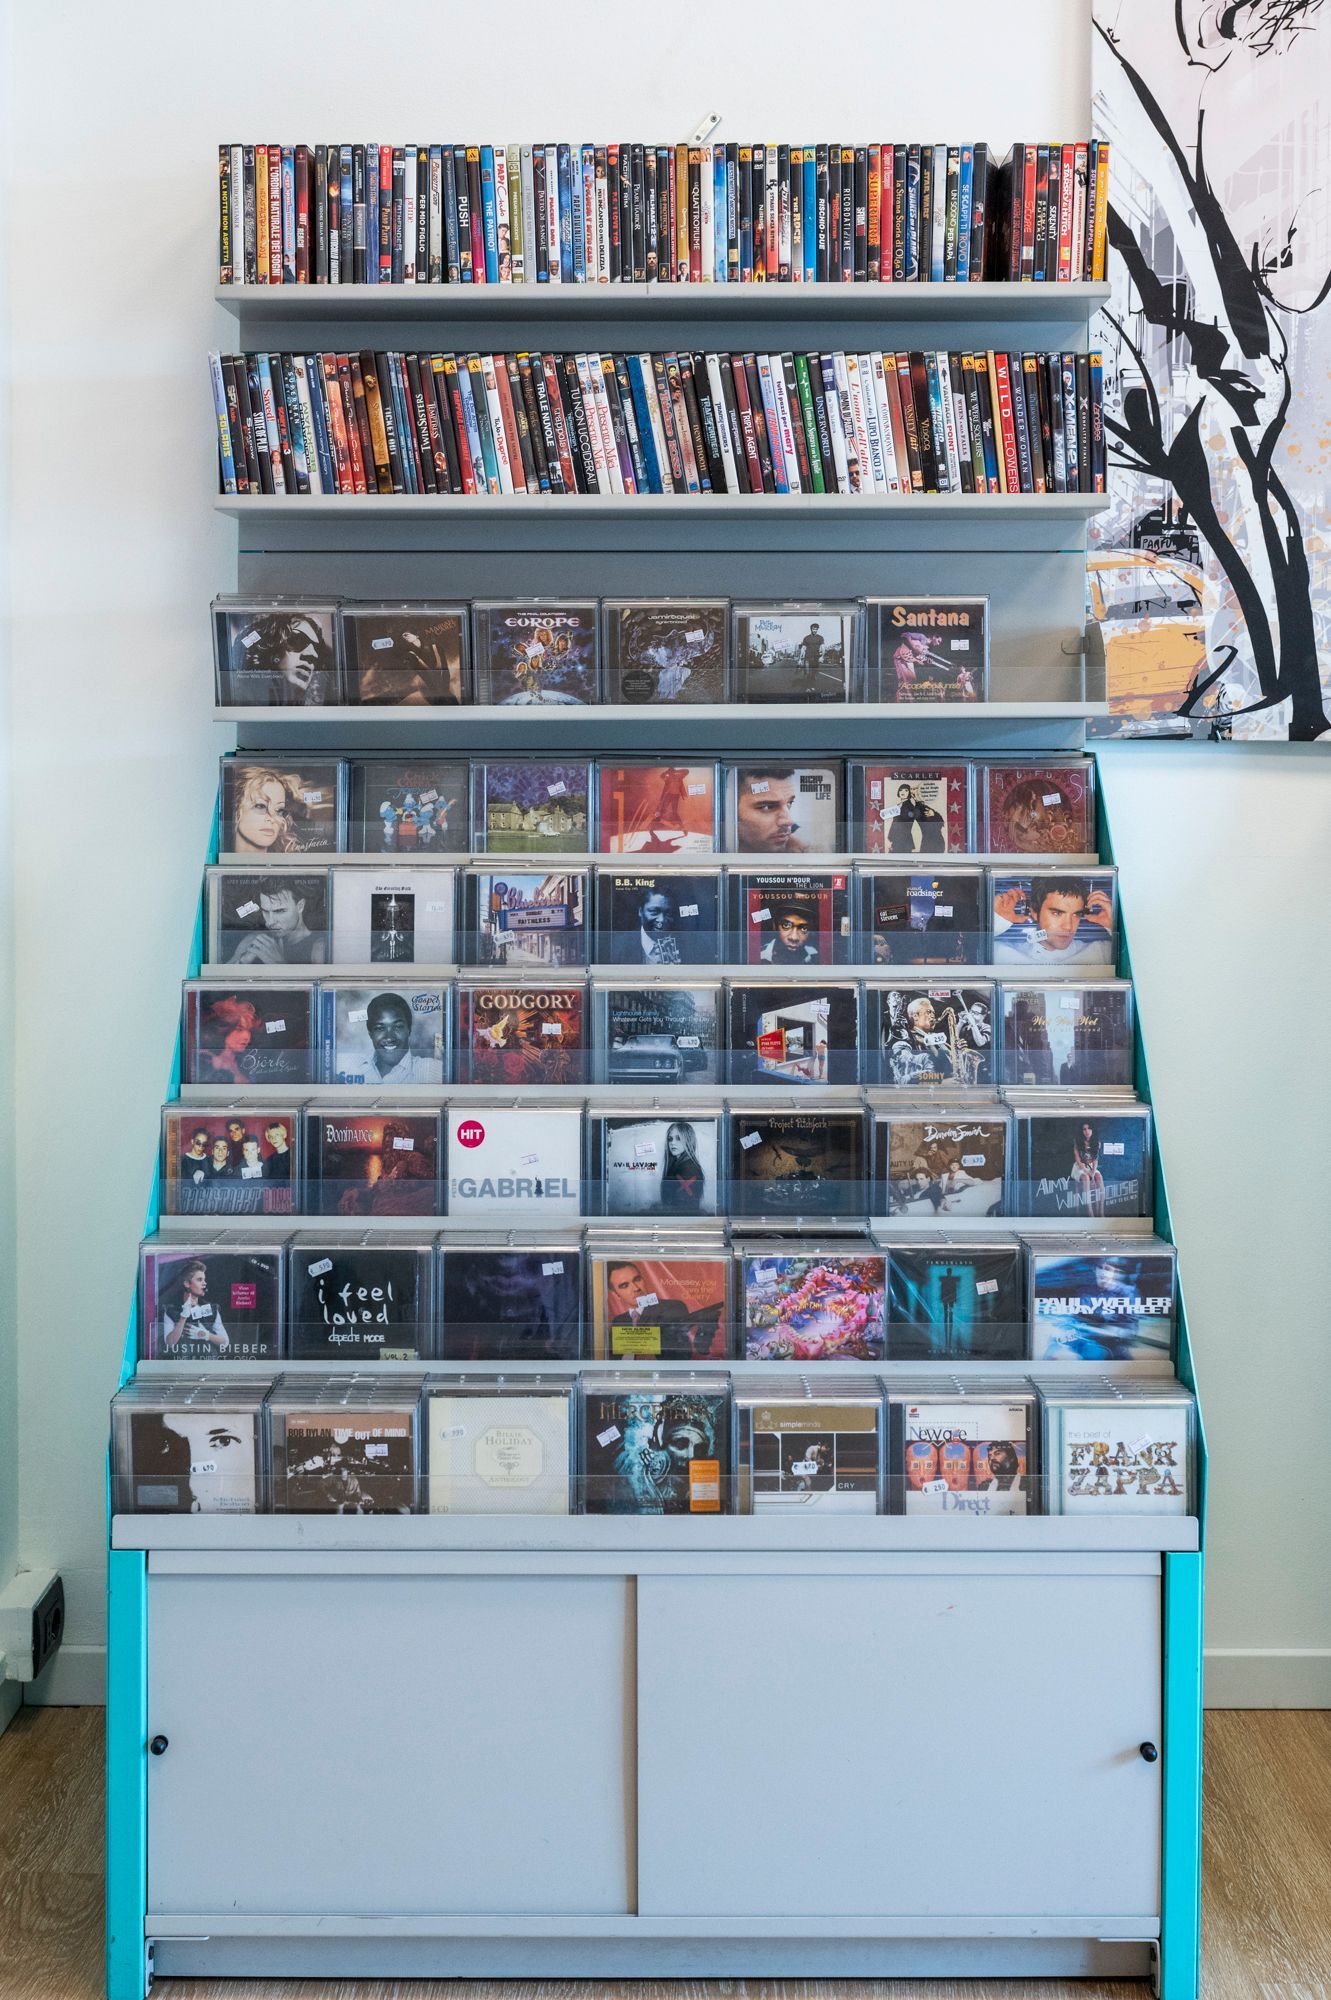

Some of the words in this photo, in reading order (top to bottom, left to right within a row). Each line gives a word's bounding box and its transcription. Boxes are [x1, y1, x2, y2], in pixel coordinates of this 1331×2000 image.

[222, 180, 228, 189] LA
[270, 167, 279, 199] L'ORDINE
[962, 184, 969, 192] SE
[895, 189, 903, 213] Strana
[951, 189, 957, 200] UN
[458, 196, 468, 227] PUSH
[485, 200, 493, 216] THE
[843, 189, 851, 230] RICORDATI
[271, 201, 280, 238] NATURALE
[895, 215, 903, 238] Storia
[1047, 205, 1057, 240] SERENITY
[272, 240, 280, 252] DEI
[487, 219, 495, 252] PATRIOT
[844, 240, 851, 251] ME
[272, 254, 280, 276] SOGNI
[895, 270, 904, 278] O
[227, 385, 237, 408] SPY
[288, 372, 299, 424] SUPERMAN
[537, 382, 546, 400] TRA
[570, 388, 579, 399] TU
[970, 391, 977, 402] WE
[263, 389, 275, 422] Saved!
[540, 401, 547, 411] LE
[573, 402, 584, 426] NON
[943, 385, 952, 424] VANTAGE
[971, 404, 979, 423] WERE
[1015, 387, 1027, 431] WONDER
[385, 407, 395, 436] TICKET
[741, 408, 753, 434] TRIPLE
[780, 416, 788, 428] per
[815, 396, 831, 457] UNDERWORLD
[867, 416, 876, 438] LUPO
[906, 403, 915, 432] VANITY
[1065, 393, 1076, 449] X-MEN
[219, 415, 231, 457] SOLARIS
[246, 417, 255, 459] SHADOW
[542, 412, 554, 447] NUVOLE
[998, 367, 1010, 418] WILD
[1005, 433, 1018, 492] FLOWERS
[497, 437, 508, 465] Dupree
[693, 424, 701, 443] new
[697, 445, 708, 471] moon
[746, 436, 757, 459] AGENT
[783, 429, 793, 455] mary
[857, 427, 869, 477] dell'altra
[907, 432, 919, 452] fair
[870, 439, 880, 467] BIANCO
[1019, 435, 1028, 473] WOMAN
[1054, 433, 1064, 480] X-MEN
[505, 617, 580, 629] EUROPE
[891, 606, 969, 627] Santana
[800, 776, 824, 784] RICKY
[800, 784, 831, 792] MARTIN
[815, 792, 831, 800] LIFE
[635, 879, 655, 888] King
[906, 888, 944, 898] roadsinger
[517, 917, 551, 925] FAITHLESS
[411, 996, 440, 1006] Gospel
[479, 994, 576, 1009] GODGORY
[917, 1072, 945, 1080] SONNY
[461, 1129, 482, 1139] HIT
[769, 1118, 794, 1133] Project
[1036, 1176, 1072, 1197] AMY
[1056, 1179, 1139, 1211] WINEHOUSE
[338, 1282, 393, 1307] feel
[1035, 1297, 1086, 1307] PAUL
[1089, 1297, 1171, 1307] WELLER
[323, 1304, 389, 1325] loved
[1101, 1305, 1169, 1315] STREET
[163, 1343, 211, 1354] JUSTIN
[219, 1343, 268, 1353] BIEBER
[363, 1334, 386, 1343] MODE
[288, 1428, 304, 1437] BOB
[305, 1428, 331, 1437] DYLAN
[333, 1428, 353, 1437] TIME
[355, 1431, 371, 1441] OUT
[372, 1428, 383, 1437] OF
[384, 1428, 407, 1437] MIND
[484, 1437, 534, 1446] HOLIDAY
[1066, 1441, 1178, 1467] FRANK
[838, 1482, 855, 1490] CRY
[1067, 1466, 1185, 1496] ZAPPA
[941, 1491, 991, 1512] Direct
